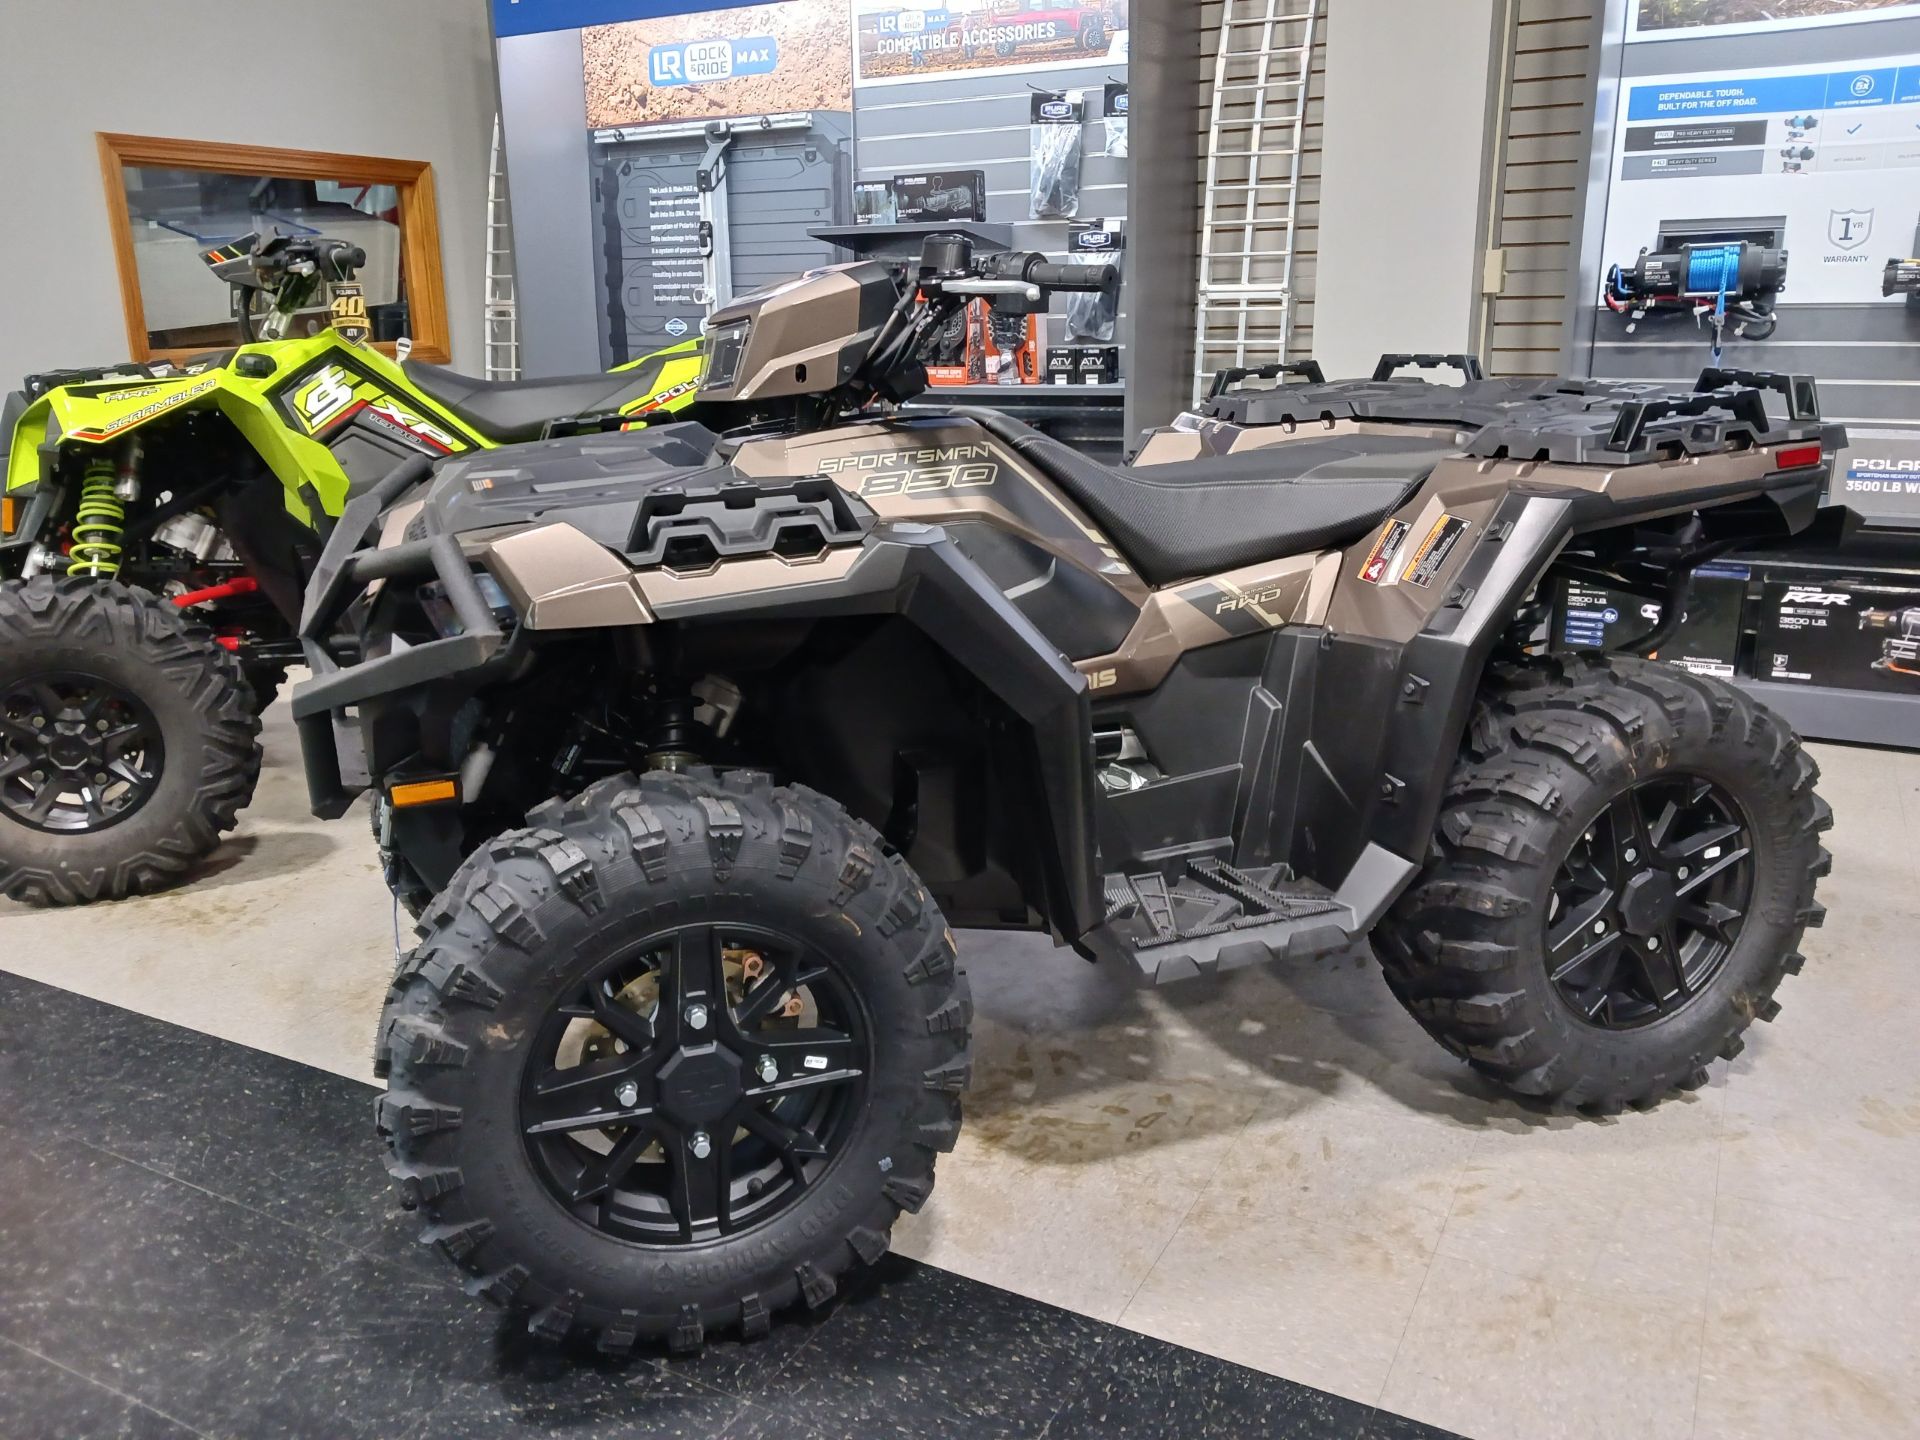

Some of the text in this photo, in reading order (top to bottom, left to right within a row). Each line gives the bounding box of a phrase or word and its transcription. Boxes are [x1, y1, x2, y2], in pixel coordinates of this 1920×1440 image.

[880, 16, 895, 33] LR
[927, 15, 946, 23] MAX
[877, 22, 1056, 55] COMPATIBLE ACCESSORIES
[690, 46, 727, 62] LOCK
[736, 49, 770, 65] MAX
[653, 50, 683, 81] LR
[697, 61, 728, 76] RIDE
[1659, 88, 1745, 101] DEPENDABLE. TOUGH.
[1658, 97, 1758, 111] BUILT FOR THE OFF ROAD.
[1839, 218, 1853, 241] 1
[1823, 255, 1869, 263] WARRANTY
[331, 296, 364, 316] 40
[1050, 357, 1072, 366] ATV
[1081, 356, 1103, 366] ATV
[106, 379, 217, 431] SCRAMBLER
[367, 398, 454, 446] XP
[368, 413, 422, 444] 1000
[817, 445, 990, 475] SPORTSMAN
[857, 462, 998, 499] 850
[1845, 480, 1881, 492] 3500
[1882, 481, 1902, 493] LB
[1215, 588, 1282, 615] AWD
[1568, 595, 1593, 603] 3500
[1780, 591, 1852, 606] RZR
[1779, 616, 1810, 626] 3500
